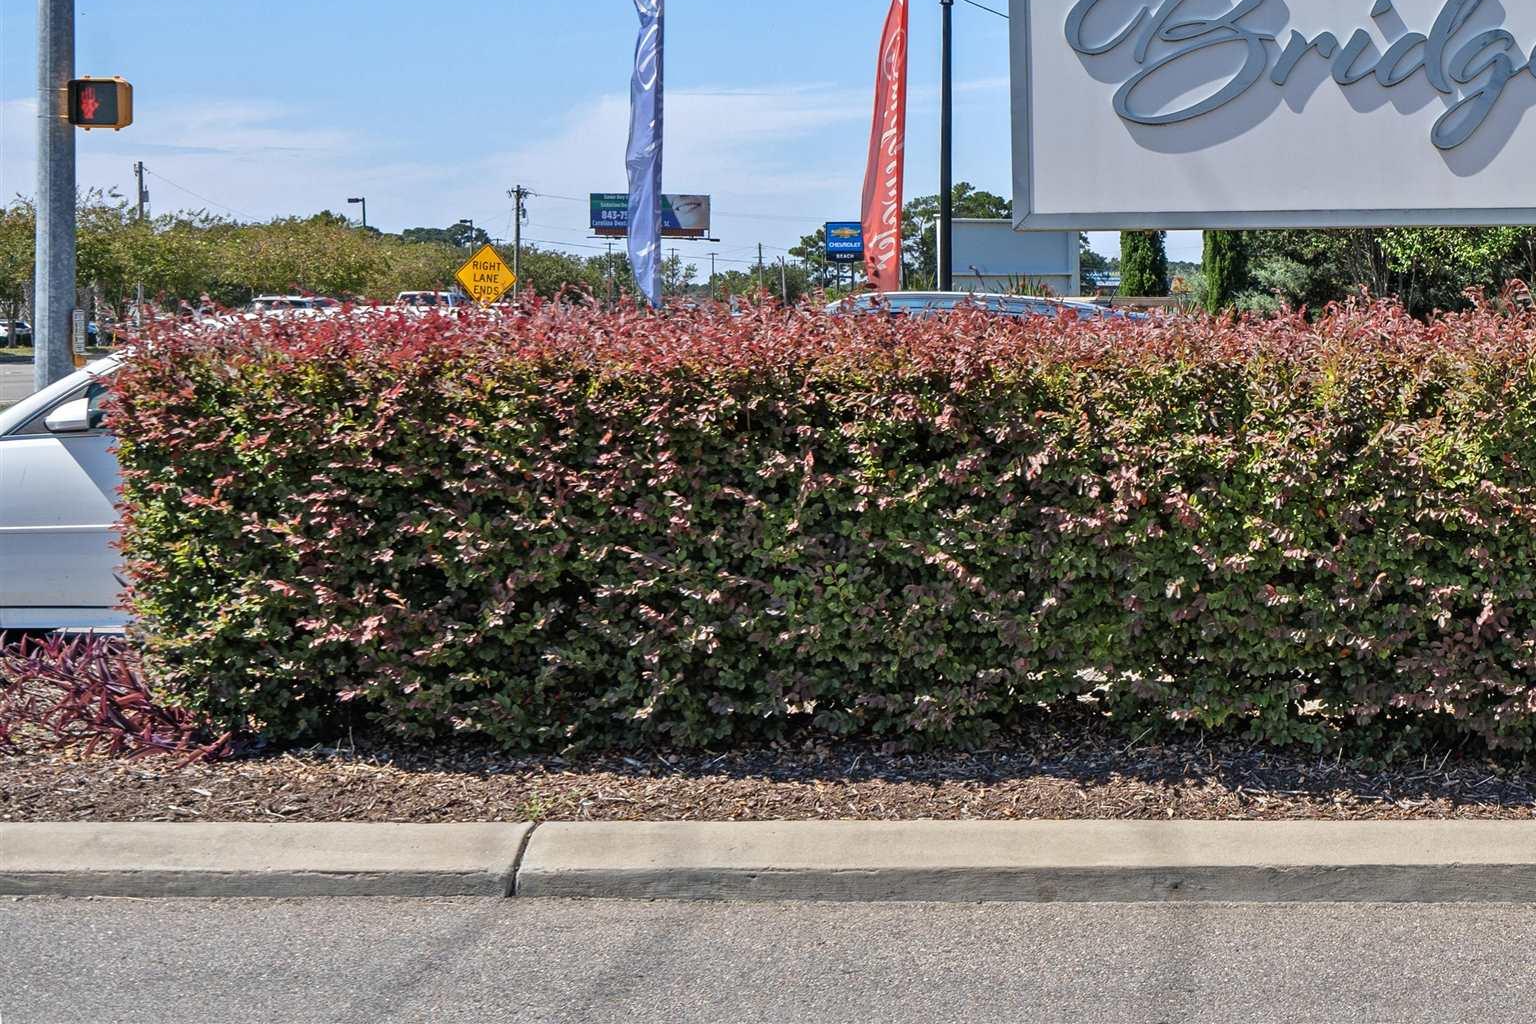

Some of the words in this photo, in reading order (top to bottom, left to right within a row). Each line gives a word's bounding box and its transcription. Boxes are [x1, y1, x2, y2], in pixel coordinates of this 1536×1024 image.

[472, 260, 501, 272] RIGHT
[473, 273, 500, 284] LANE
[473, 285, 500, 296] ENDS
